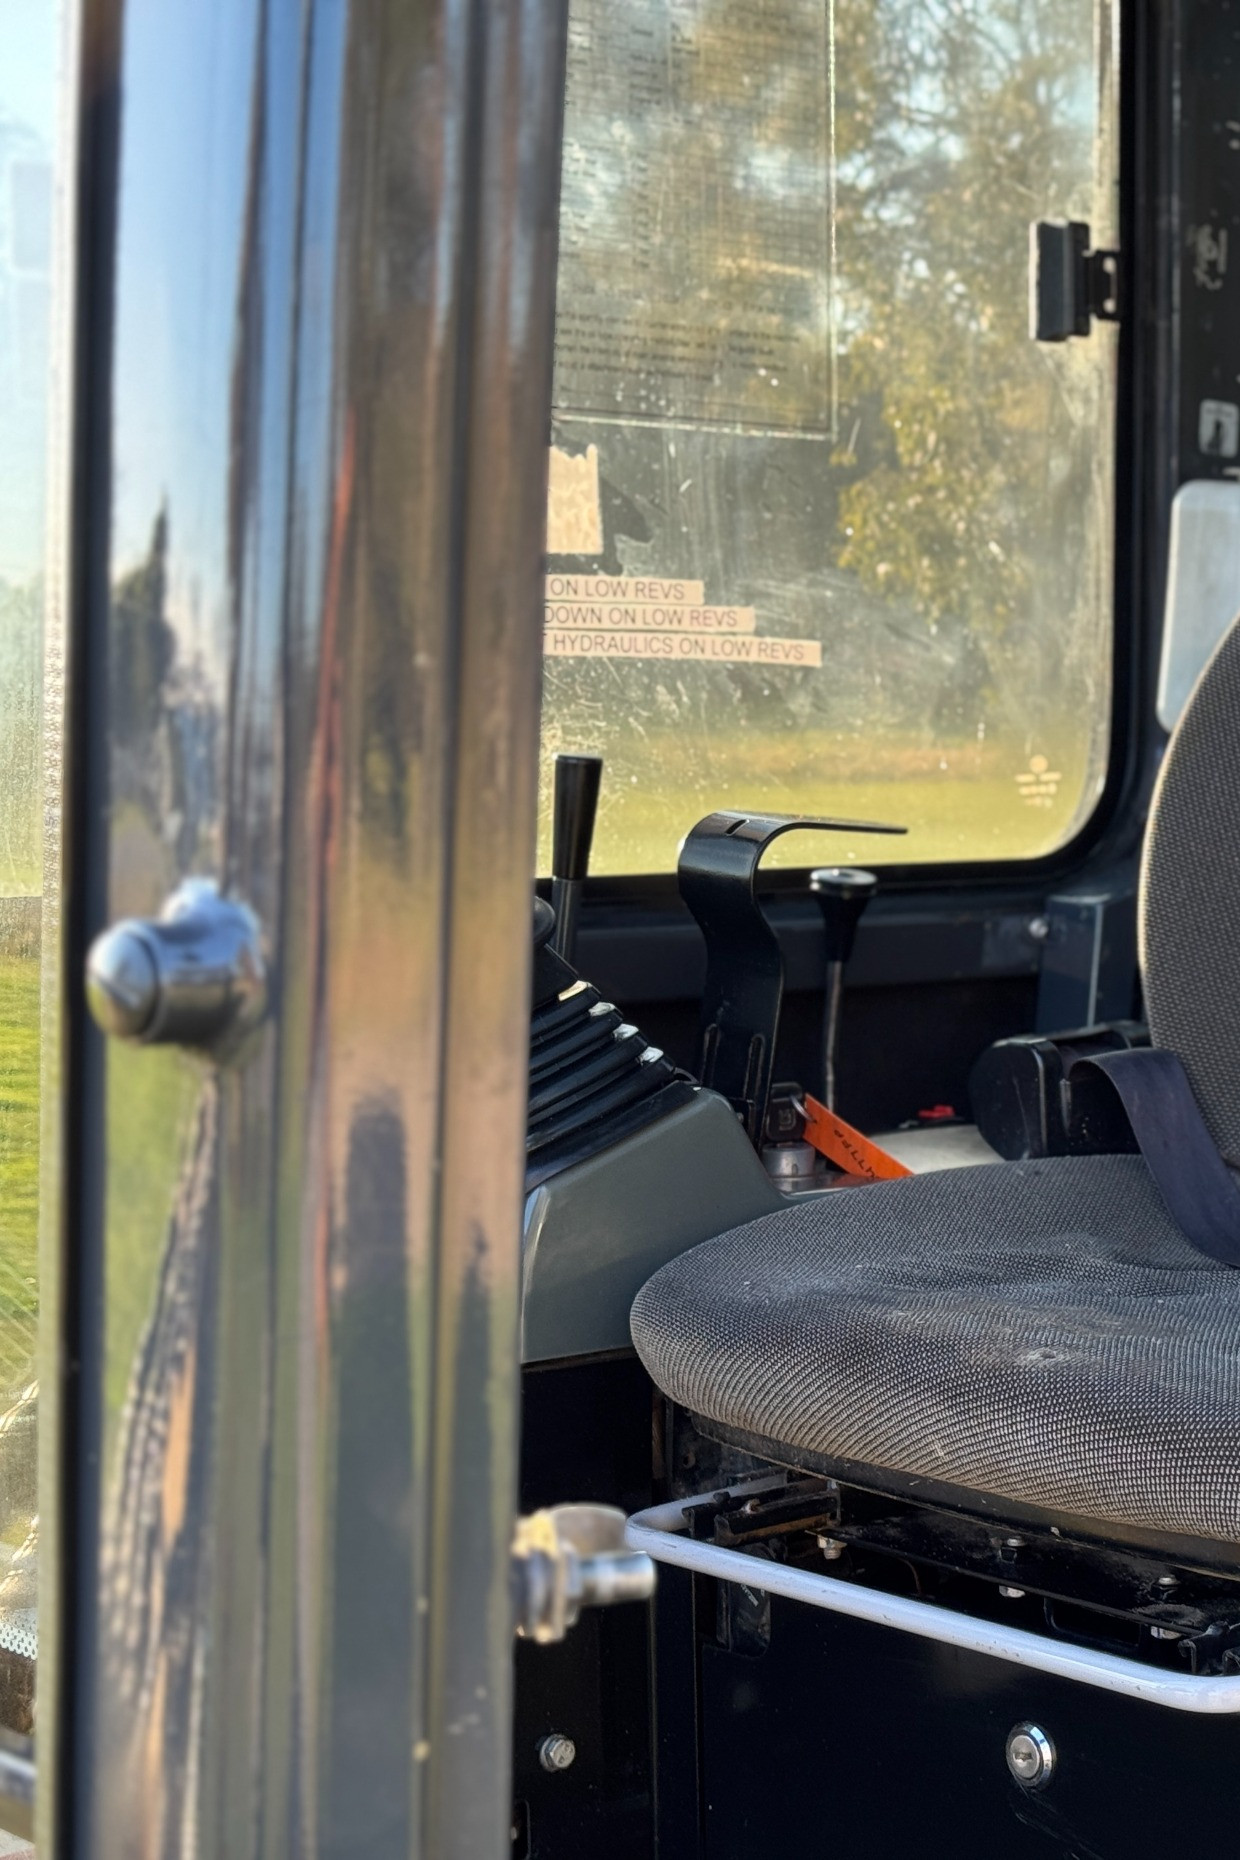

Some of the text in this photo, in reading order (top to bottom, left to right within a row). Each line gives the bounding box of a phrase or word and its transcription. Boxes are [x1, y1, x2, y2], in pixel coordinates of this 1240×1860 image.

[550, 578, 684, 600] ON LOW REVS
[545, 606, 737, 627] DOWN ON LOW REVS
[554, 634, 804, 661] HYDRAULICS ON LOW REVS
